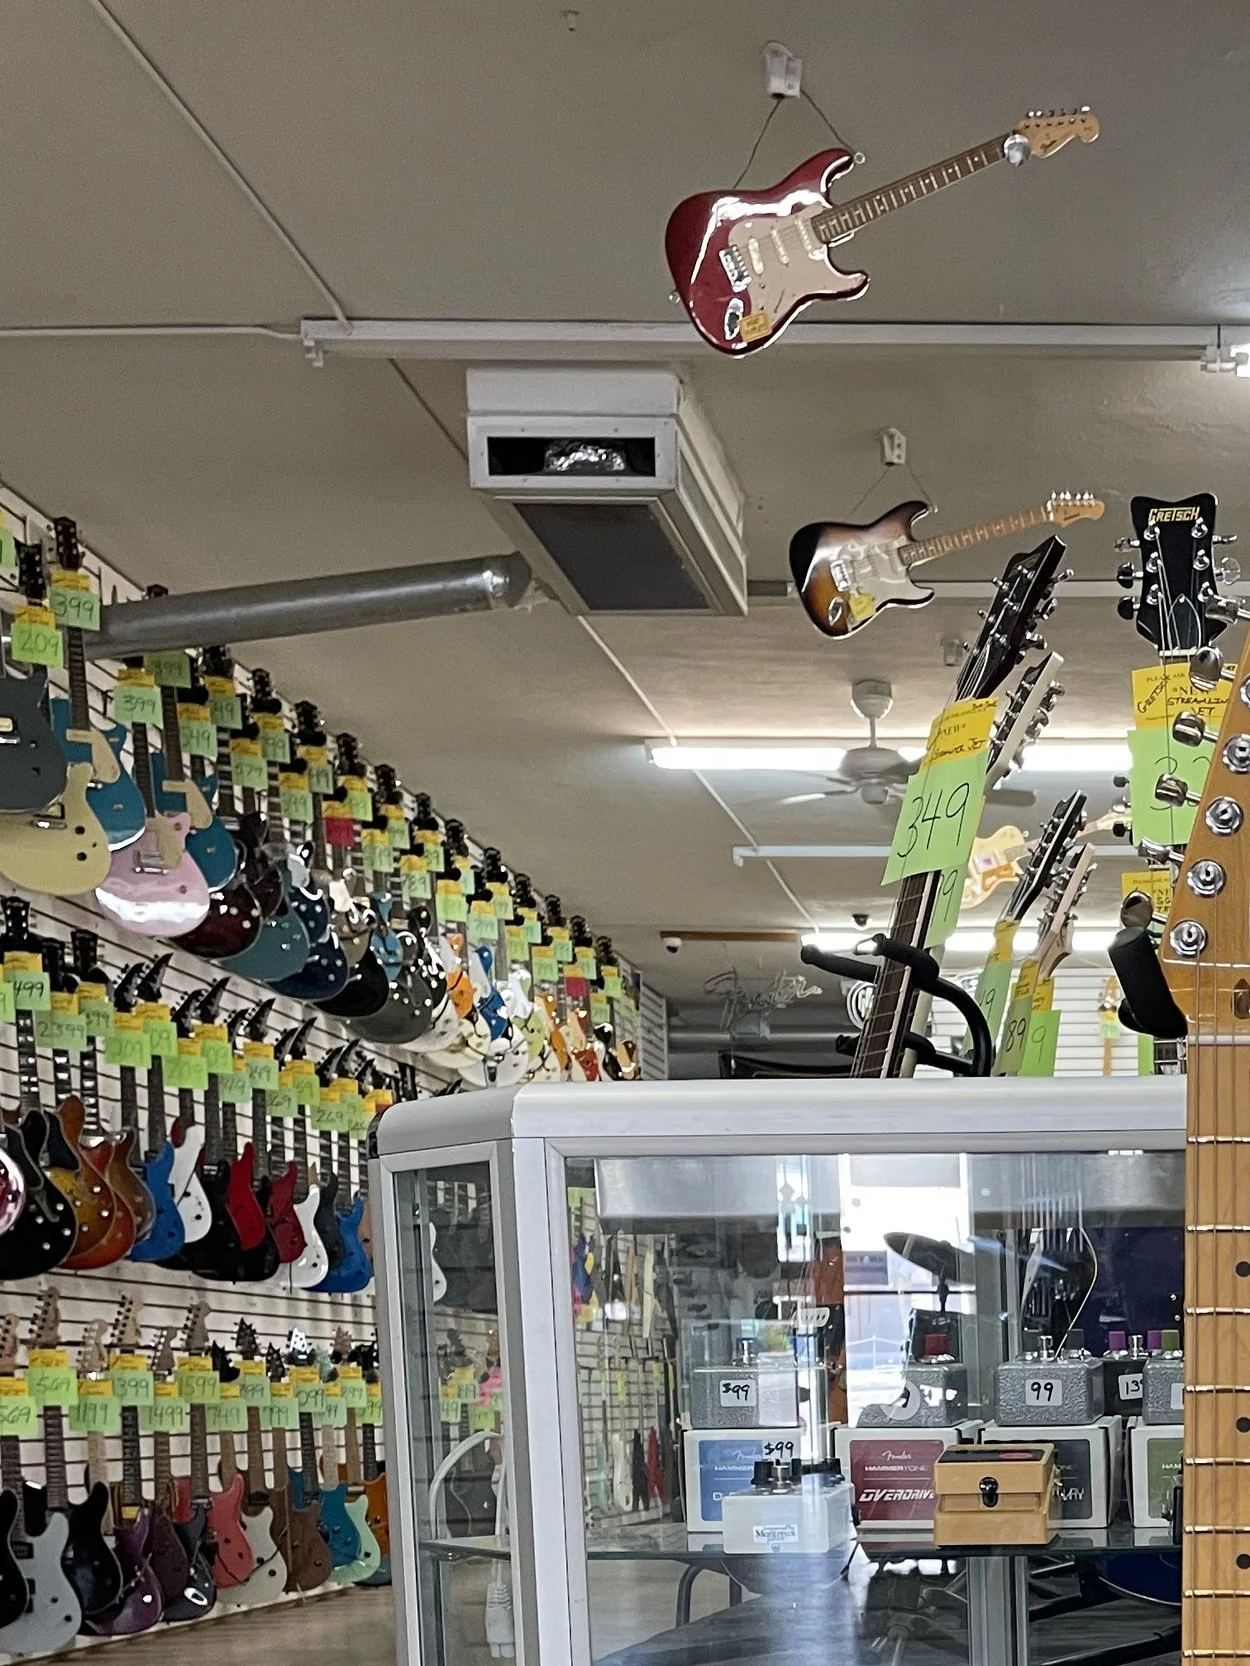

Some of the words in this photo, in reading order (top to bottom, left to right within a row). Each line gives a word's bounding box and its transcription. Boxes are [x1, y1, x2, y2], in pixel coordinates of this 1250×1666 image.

[1149, 506, 1200, 522] GRETSCH
[896, 781, 970, 858] 349
[721, 1382, 751, 1402] $99
[1030, 1381, 1054, 1402] 99
[763, 1440, 795, 1459] $99
[858, 1488, 935, 1502] OVERDRIVE
